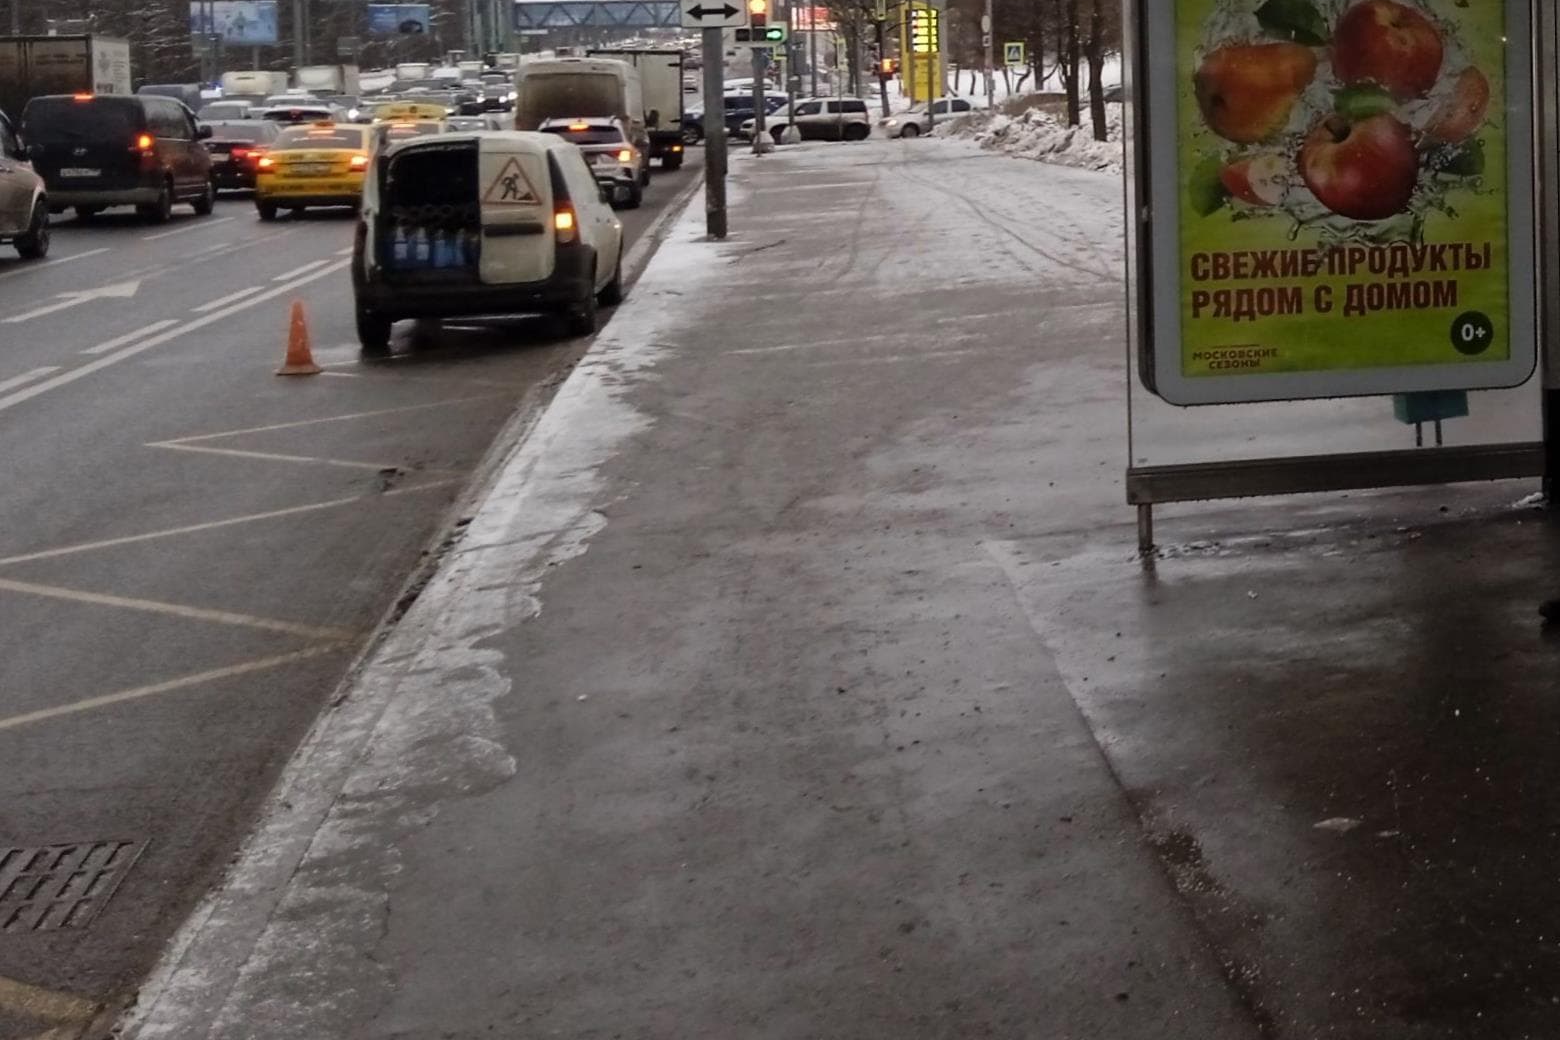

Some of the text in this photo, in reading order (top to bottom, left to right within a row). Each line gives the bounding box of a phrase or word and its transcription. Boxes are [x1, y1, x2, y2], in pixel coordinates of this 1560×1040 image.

[1191, 242, 1491, 282] СВЕЖИЕ ПРОДУКТЫ
[1191, 279, 1458, 322] РЯДОМ С ДОМОМ
[1460, 323, 1487, 342] 0+
[1192, 347, 1278, 361] МОСКОВСКИЕ
[1209, 358, 1261, 371] СЕЗОНЫ
